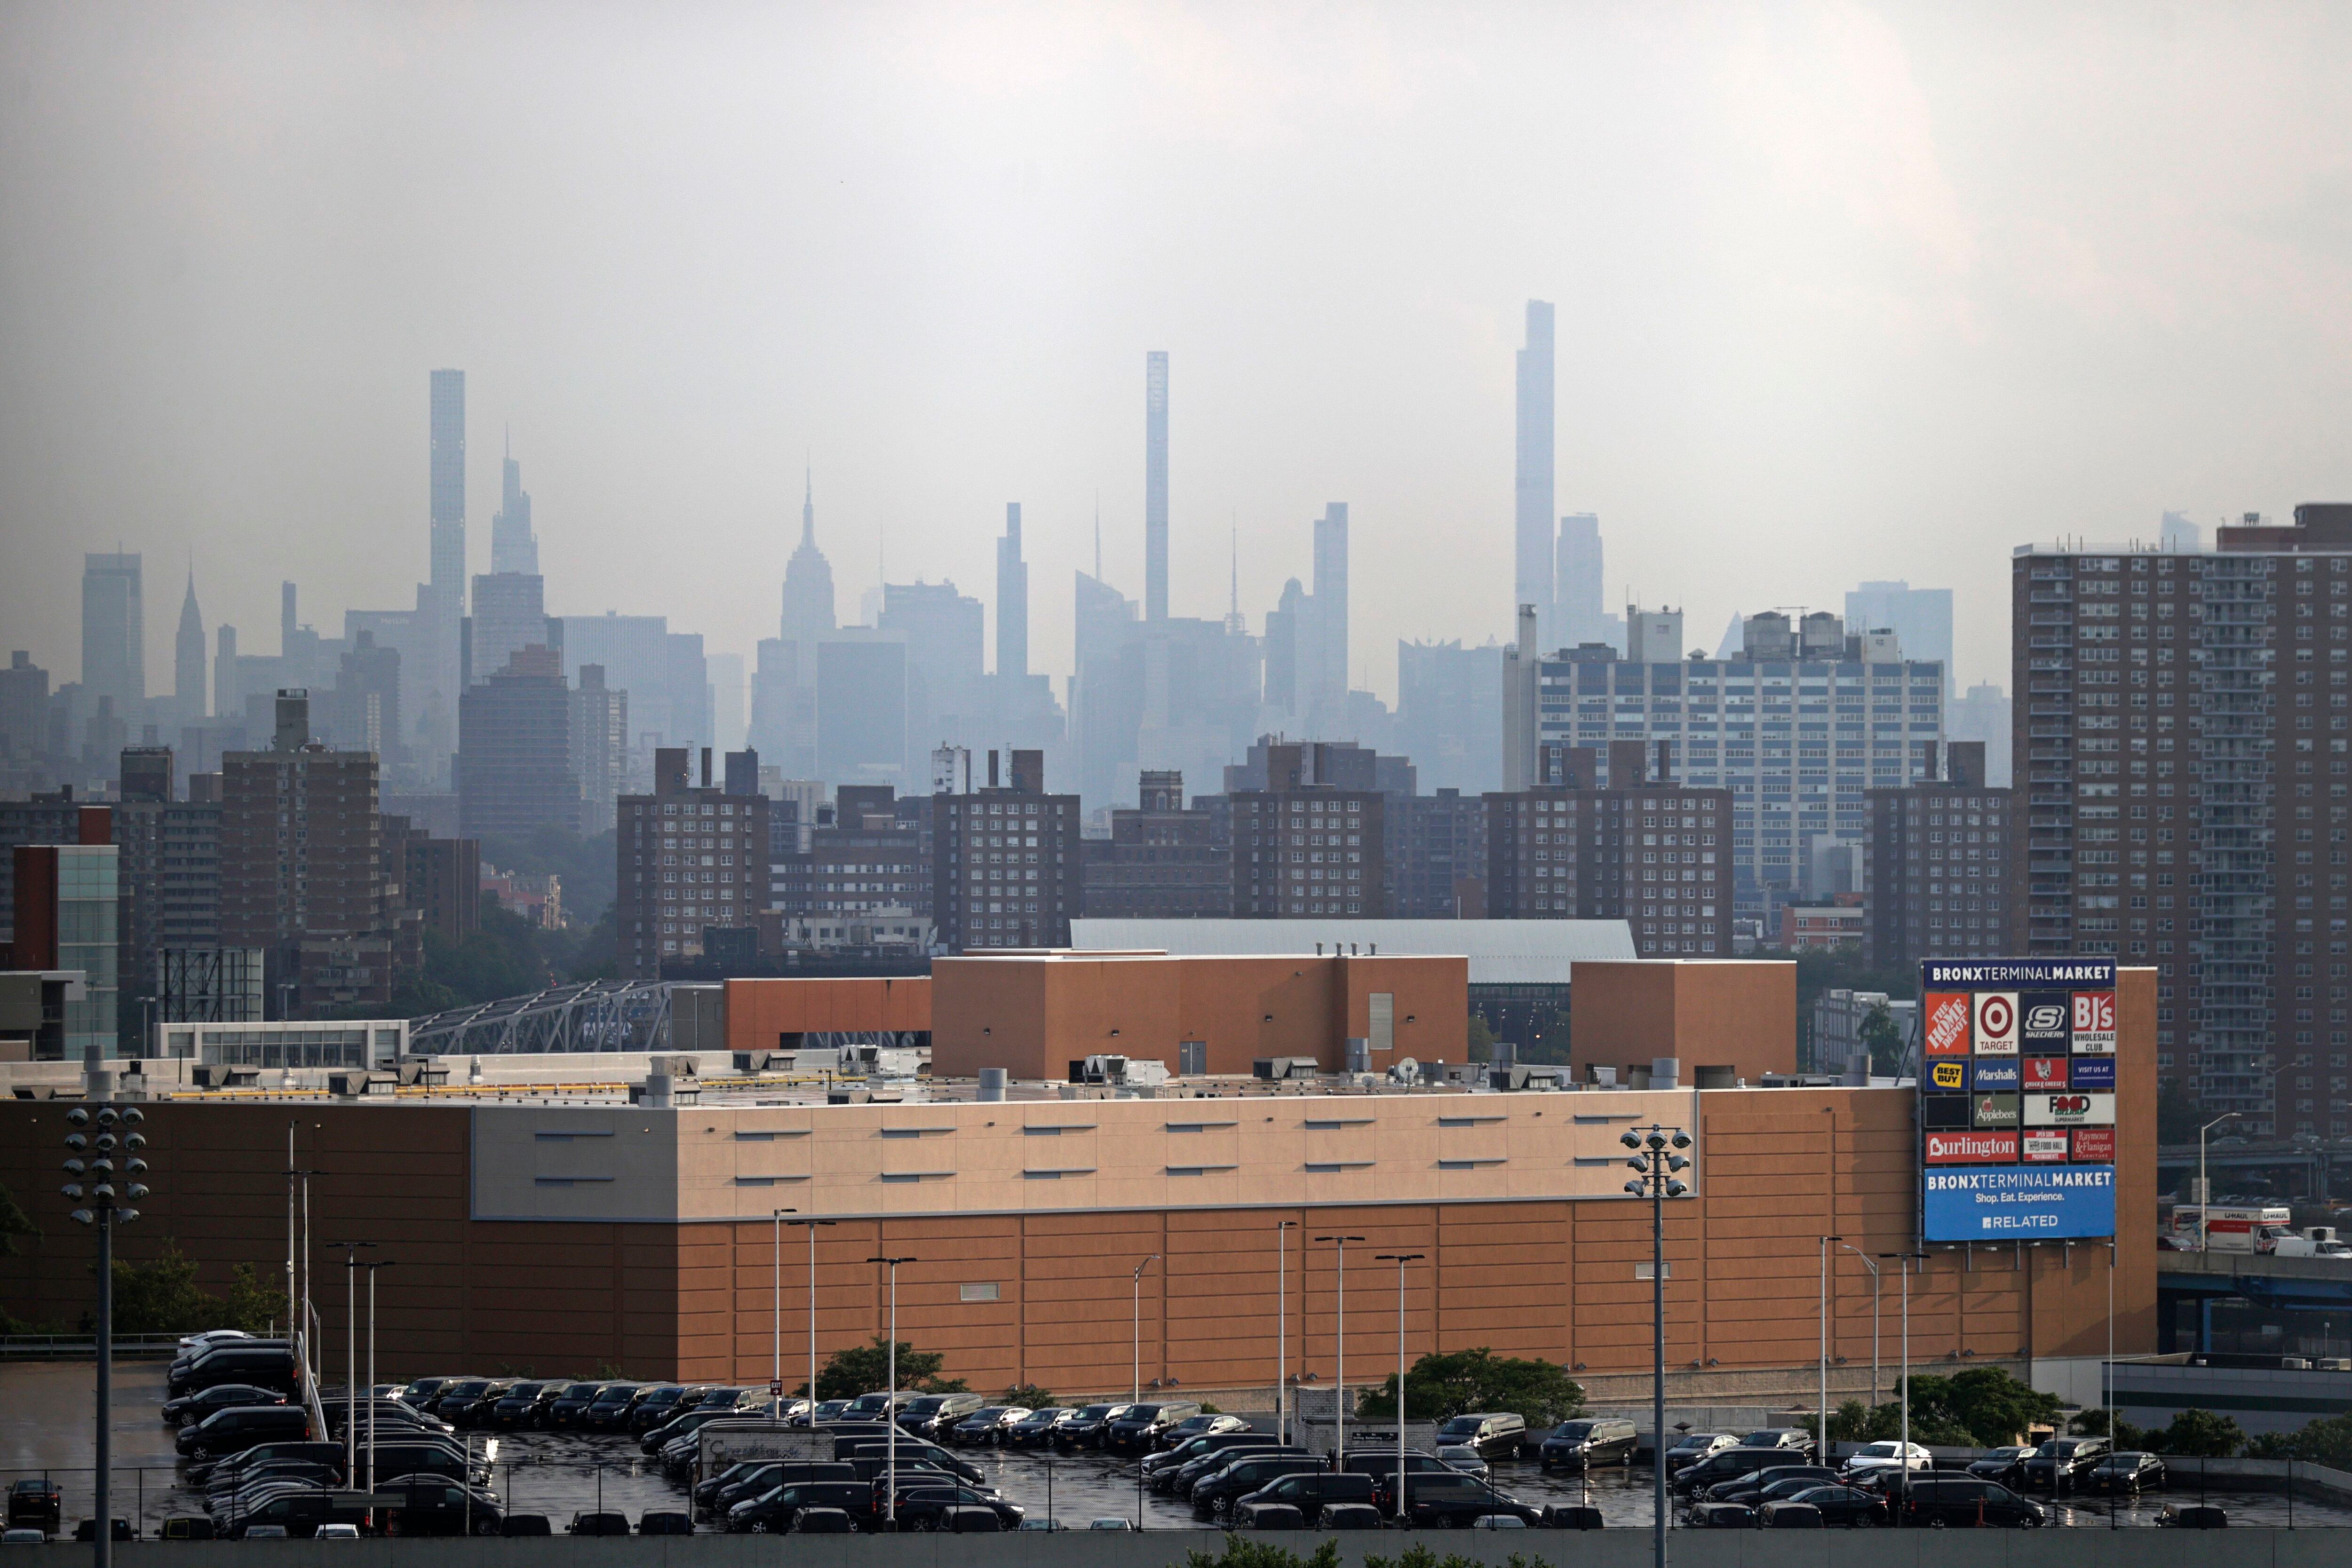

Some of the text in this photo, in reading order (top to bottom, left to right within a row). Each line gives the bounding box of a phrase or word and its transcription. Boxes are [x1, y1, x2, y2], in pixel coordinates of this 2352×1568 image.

[1931, 1000, 1949, 1024] THE
[1927, 998, 1967, 1049] HOME
[1941, 1015, 1968, 1049] DEPOT
[2074, 1033, 2115, 1041] WHOLESALE
[1980, 1041, 2014, 1051] TARGET
[2085, 1043, 2103, 1052] CLUB
[1937, 1067, 1961, 1076] BEST
[1976, 1068, 2017, 1081] Marshalls
[2049, 1095, 2090, 1113] FOOD
[1976, 1108, 2017, 1122] Applebee's
[2079, 1131, 2108, 1141] Raymour
[1930, 1137, 2015, 1157] Burlington
[2041, 1141, 2051, 1150] FOOD
[2052, 1141, 2062, 1150] HALL
[1976, 1191, 2065, 1204] Shop. Eat. Experience.
[1993, 1215, 2058, 1228] RELATED
